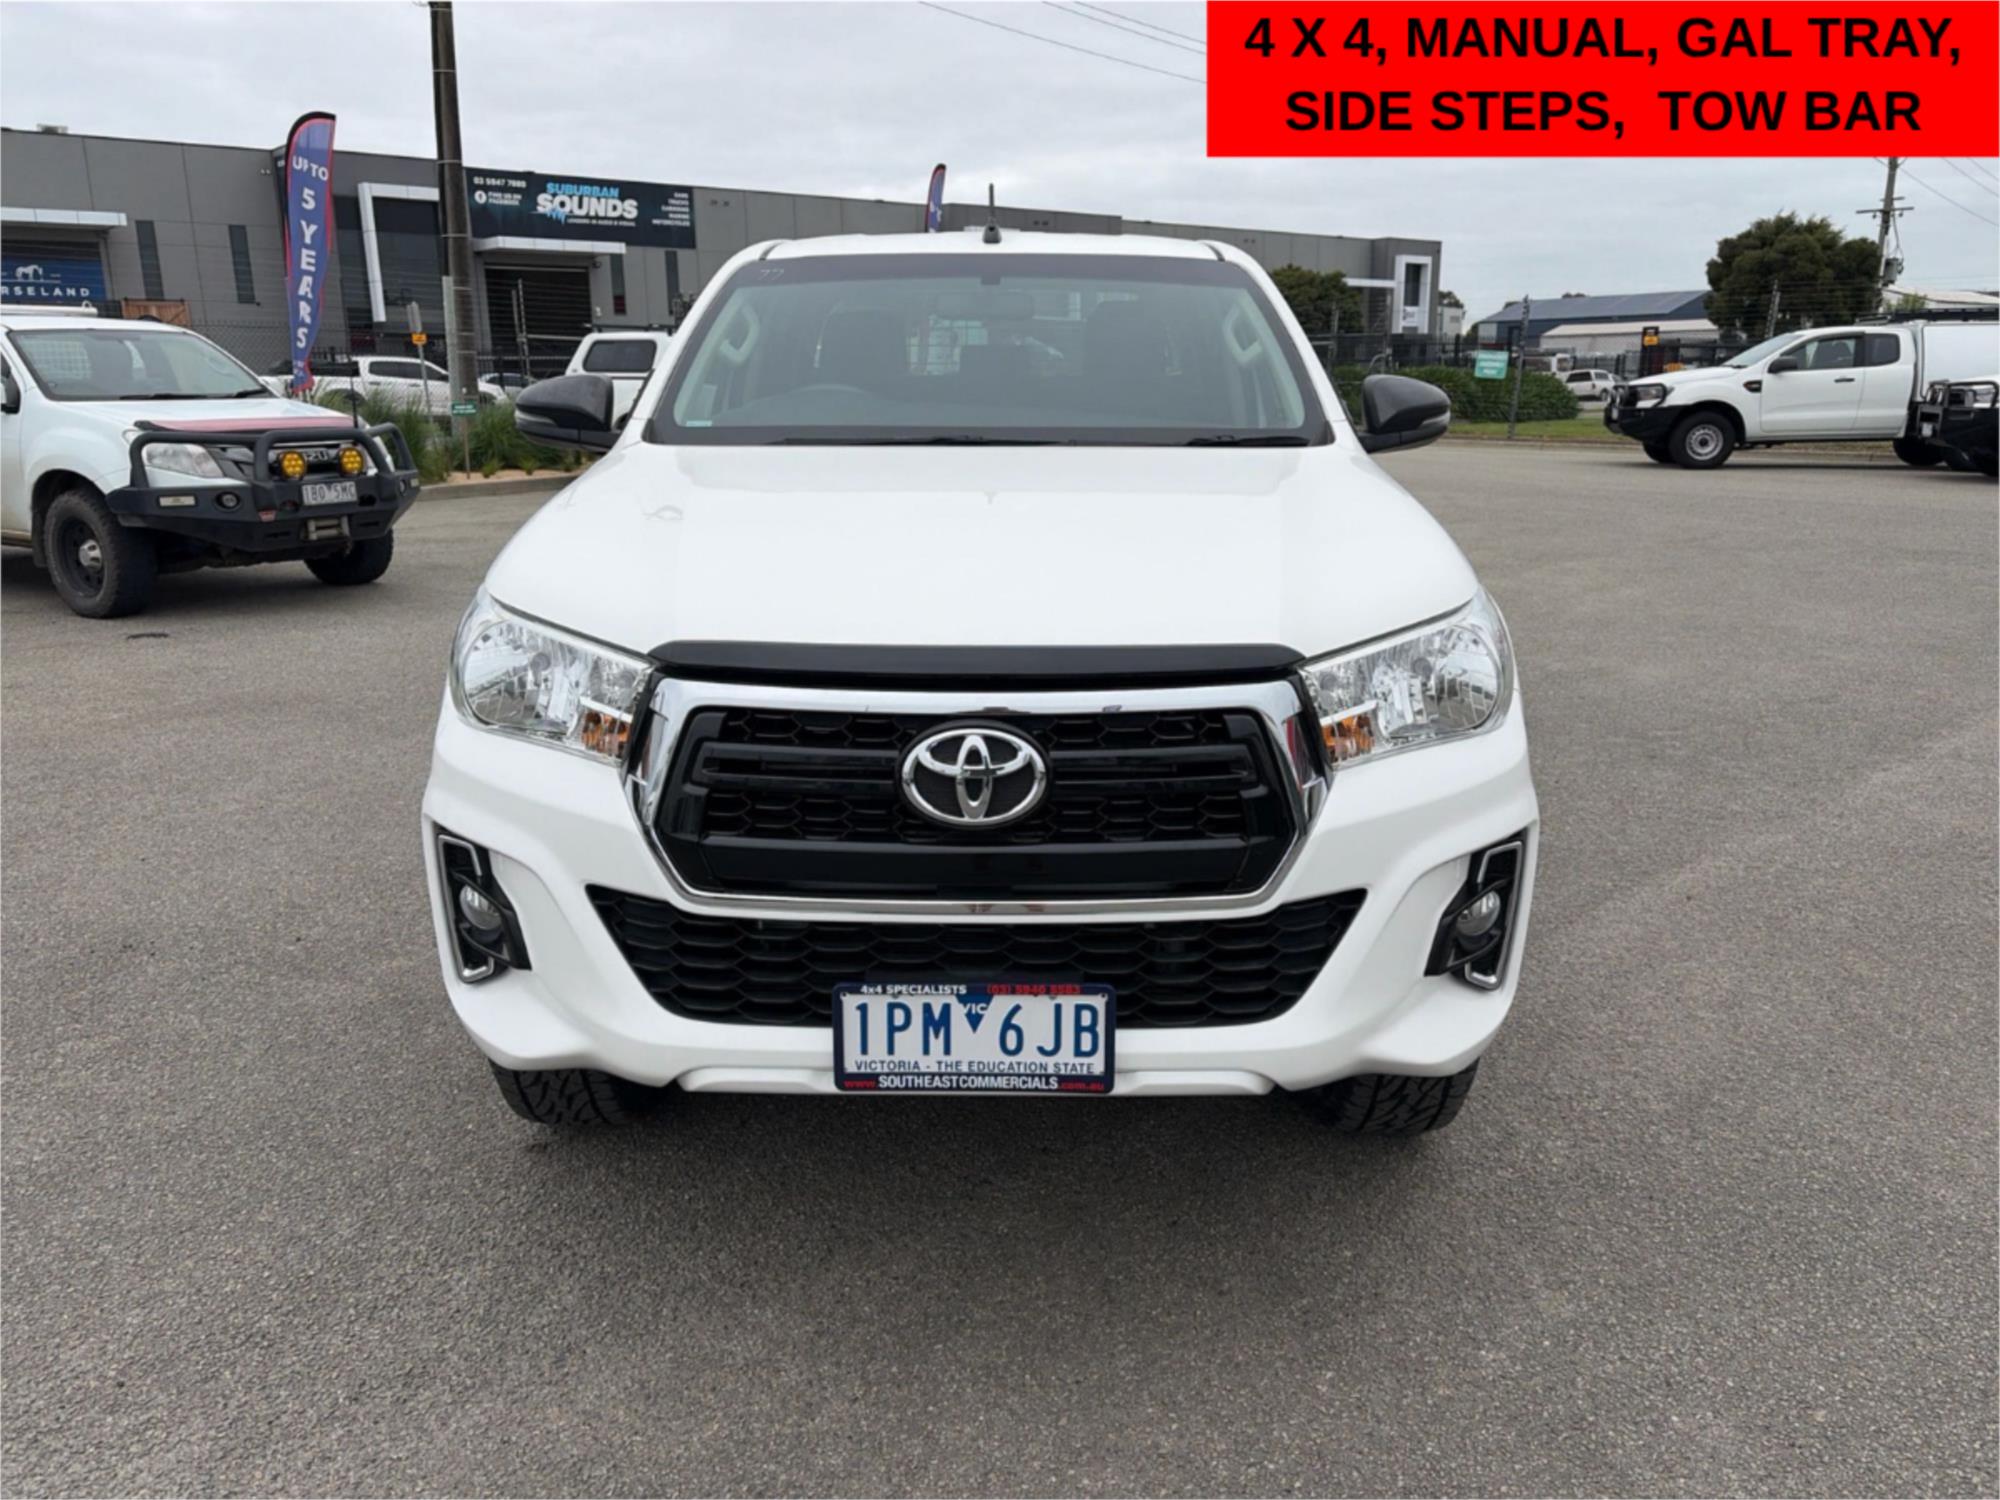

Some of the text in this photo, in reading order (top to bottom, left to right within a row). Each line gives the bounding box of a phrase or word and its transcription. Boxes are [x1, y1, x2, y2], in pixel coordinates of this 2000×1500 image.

[310, 164, 328, 181] TO
[302, 187, 316, 211] 5
[546, 182, 619, 198] SUBURBAN
[536, 193, 639, 219] SOUNDS
[297, 220, 317, 348] YEARS
[886, 984, 967, 995] SPECIALISTS
[855, 1002, 1099, 1058] 1PM VIC 6JB
[855, 1060, 921, 1072] VICTORIA
[936, 1061, 963, 1073] THE
[967, 1061, 1048, 1074] EDUCATION
[1053, 1062, 1095, 1075] STATE
